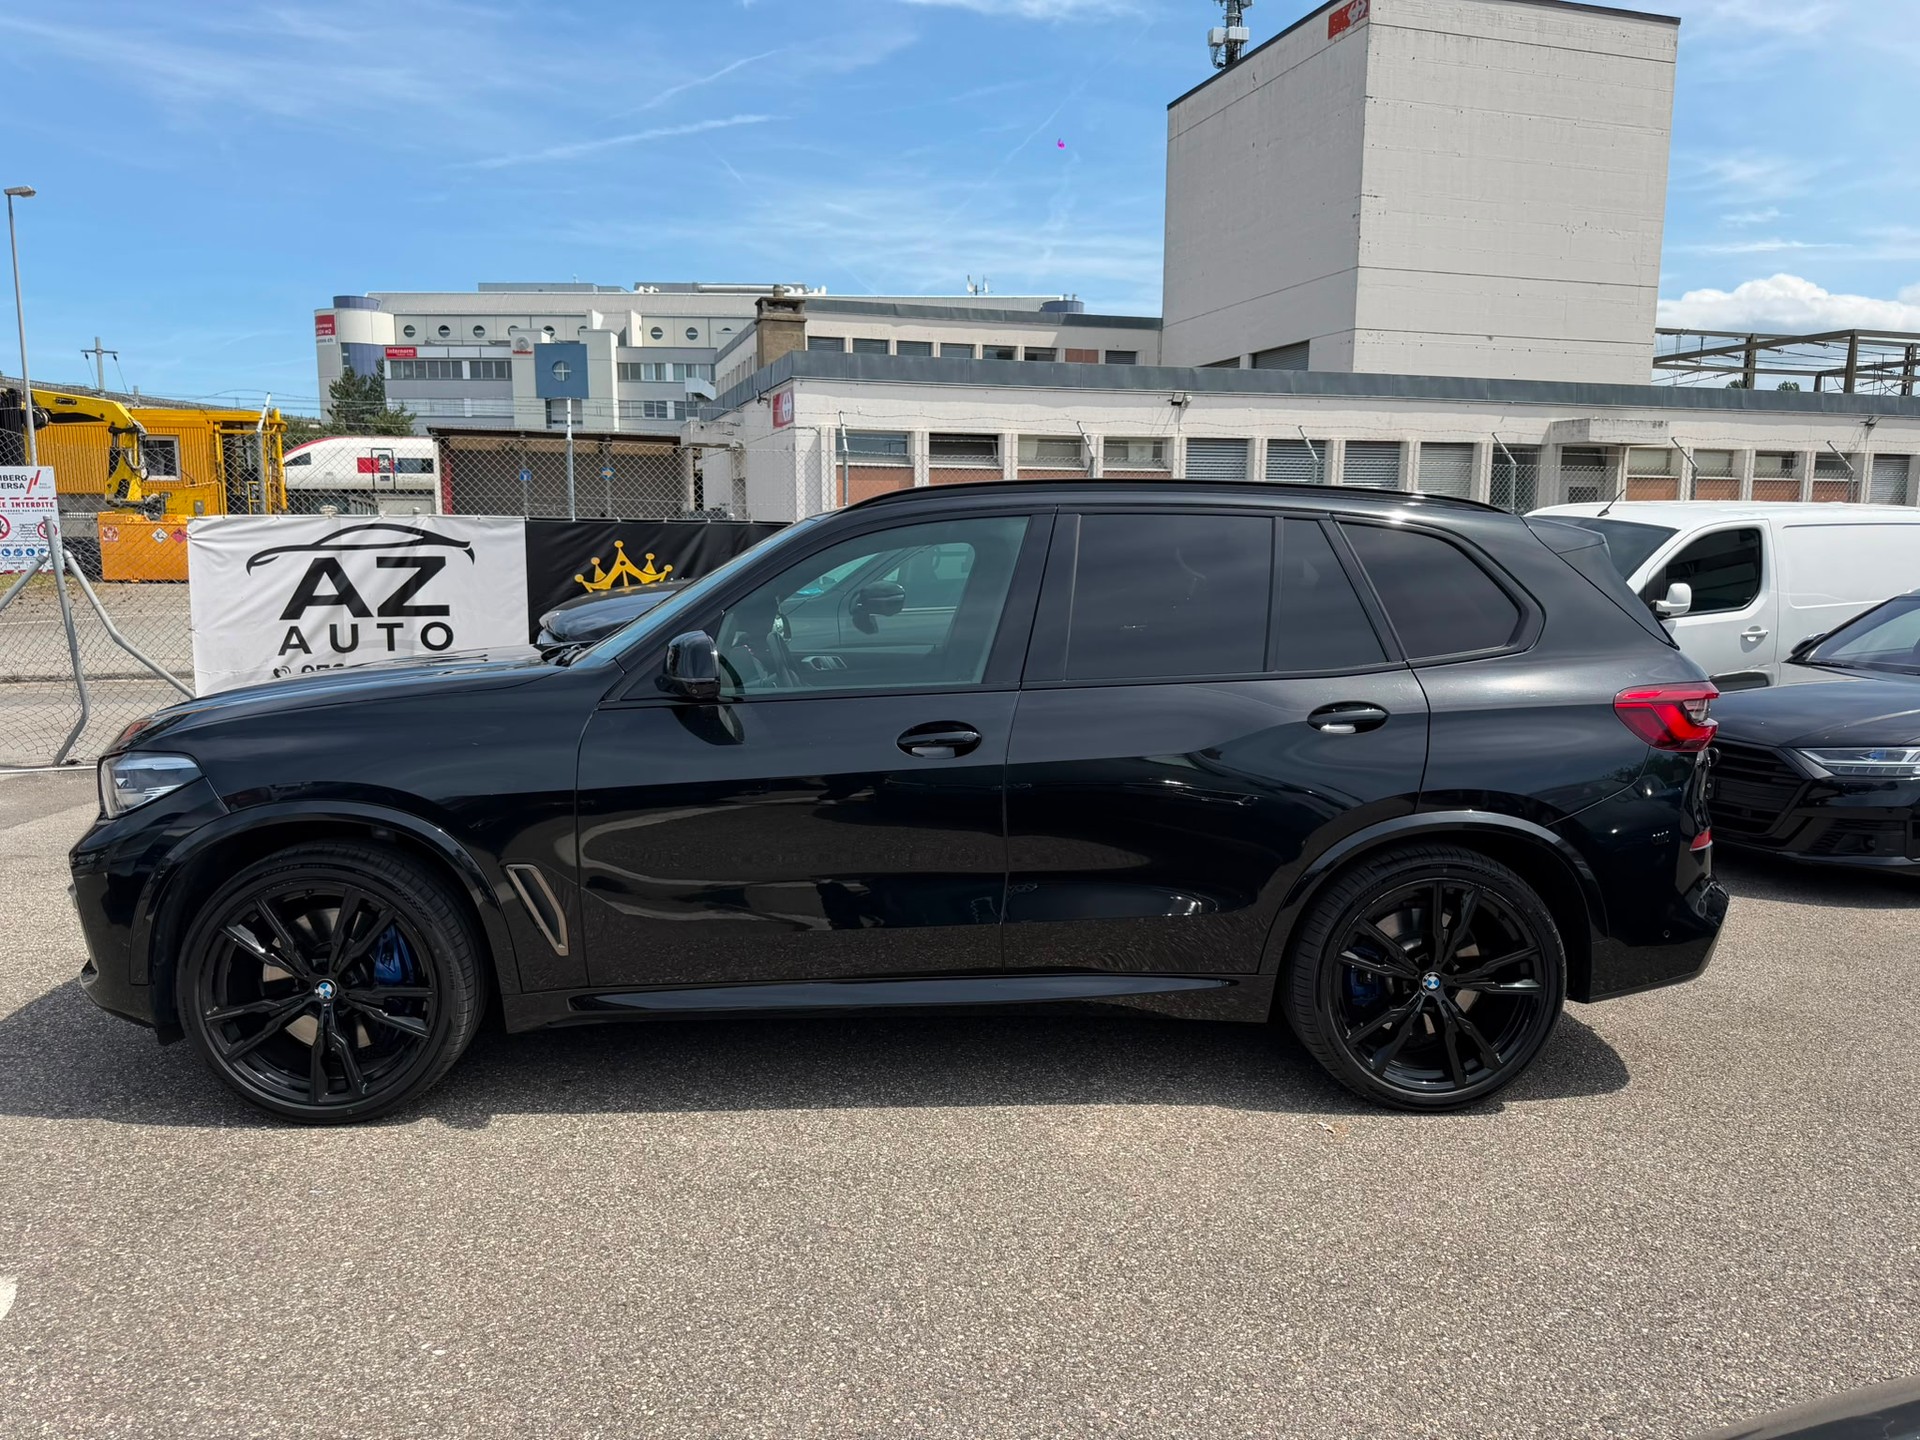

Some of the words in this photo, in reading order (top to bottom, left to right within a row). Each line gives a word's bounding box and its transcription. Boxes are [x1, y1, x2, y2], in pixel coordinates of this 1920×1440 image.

[0, 482, 26, 490] ERSA
[279, 556, 450, 621] AZ
[277, 621, 455, 656] AUTO
